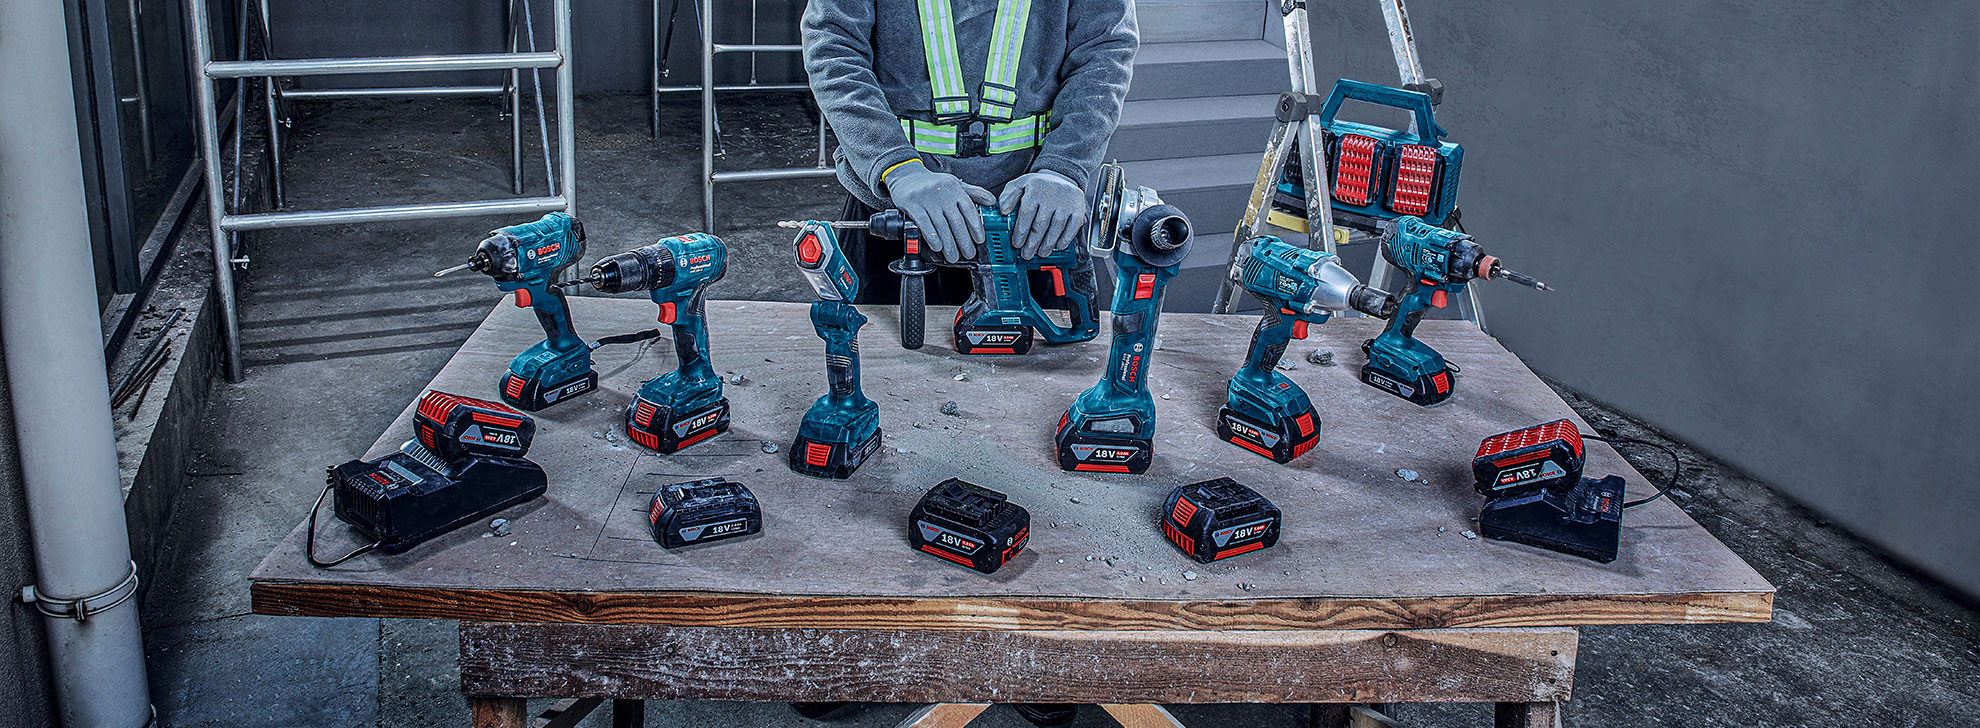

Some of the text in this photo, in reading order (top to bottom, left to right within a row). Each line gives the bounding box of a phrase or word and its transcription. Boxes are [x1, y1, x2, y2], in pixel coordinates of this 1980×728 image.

[537, 243, 560, 255] BOSCH
[690, 254, 711, 264] BOSCH
[843, 271, 853, 285] BOSCH
[1128, 355, 1140, 382] BOSCH
[1373, 376, 1386, 385] 18V
[565, 385, 579, 395] 18V
[692, 416, 707, 429] 18V
[1231, 422, 1249, 434] 18V
[495, 433, 517, 445] 18V
[1095, 450, 1116, 458] 18V
[369, 472, 390, 485] BOSCH
[1515, 468, 1537, 481] 18V
[712, 524, 731, 534] 18V
[1234, 527, 1253, 539] 18V
[941, 533, 962, 547] 18V
